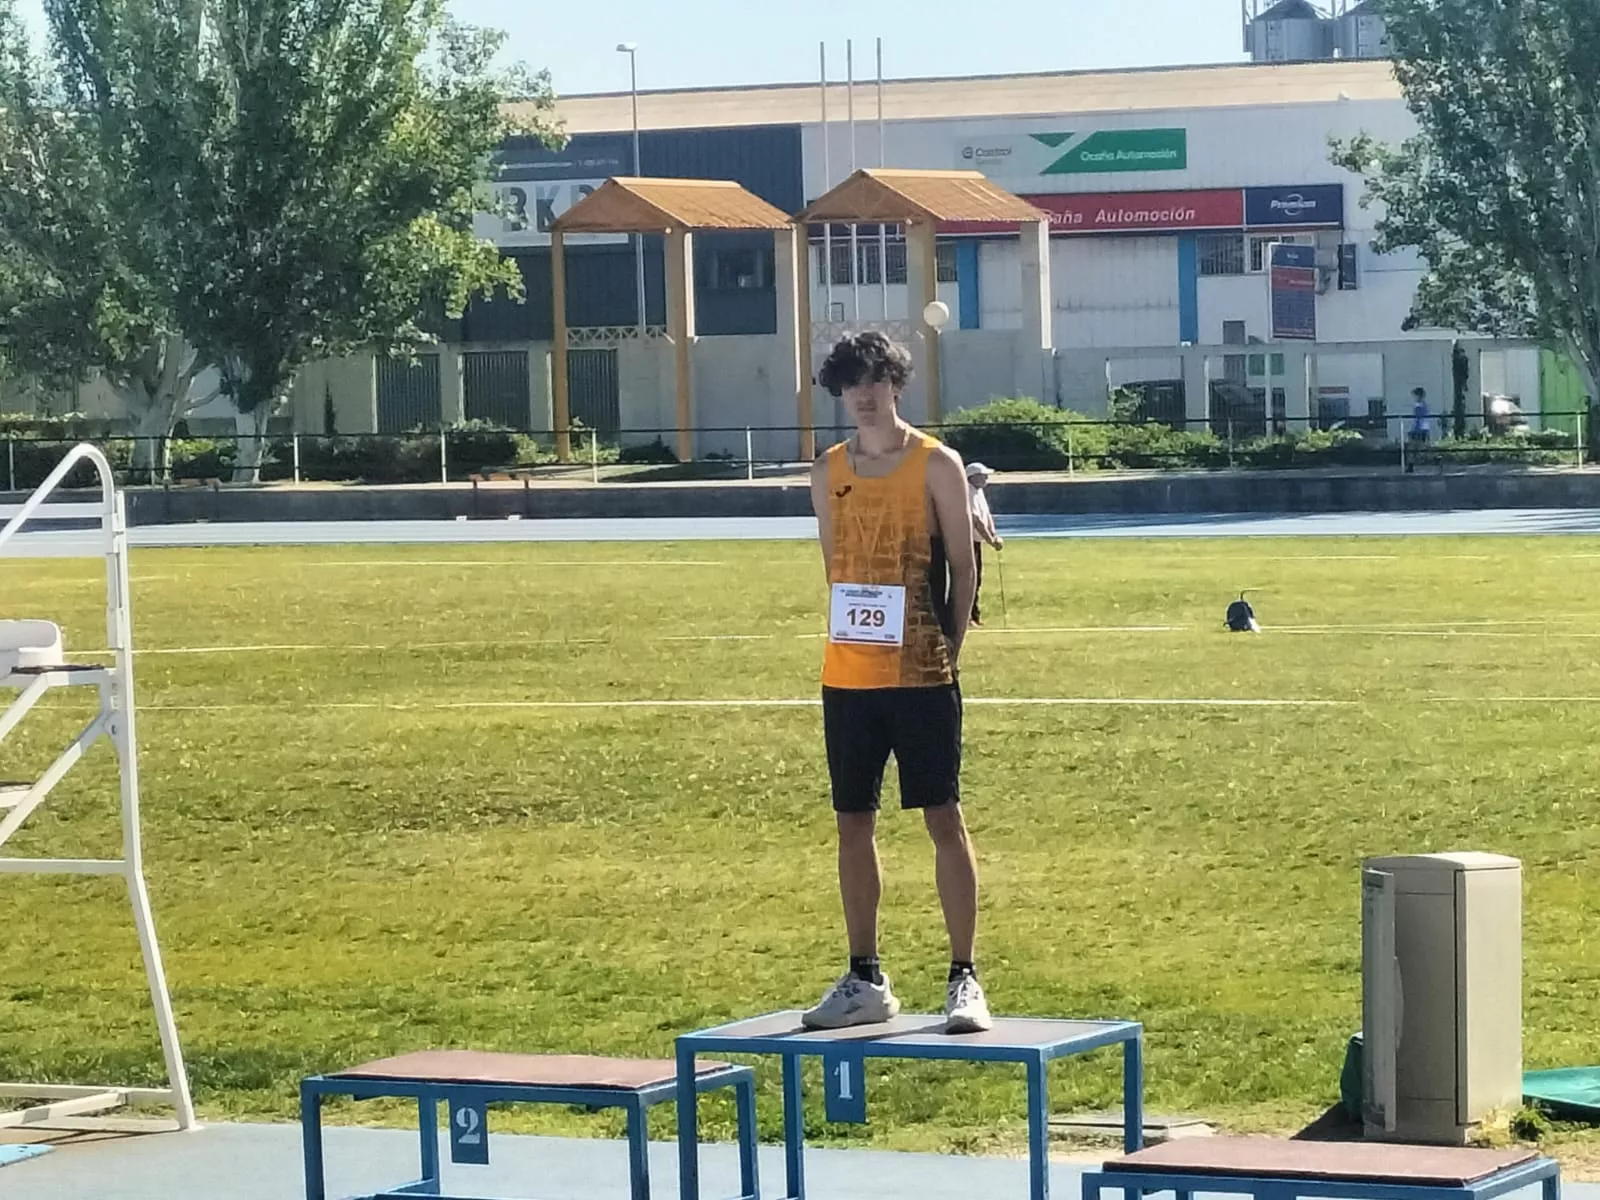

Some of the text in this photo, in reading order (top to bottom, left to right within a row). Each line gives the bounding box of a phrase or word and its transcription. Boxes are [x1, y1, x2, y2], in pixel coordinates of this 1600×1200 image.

[1049, 206, 1196, 224] aña Automoción
[846, 608, 886, 628] 129
[833, 1060, 853, 1099] 1
[456, 1107, 480, 1144] 2
